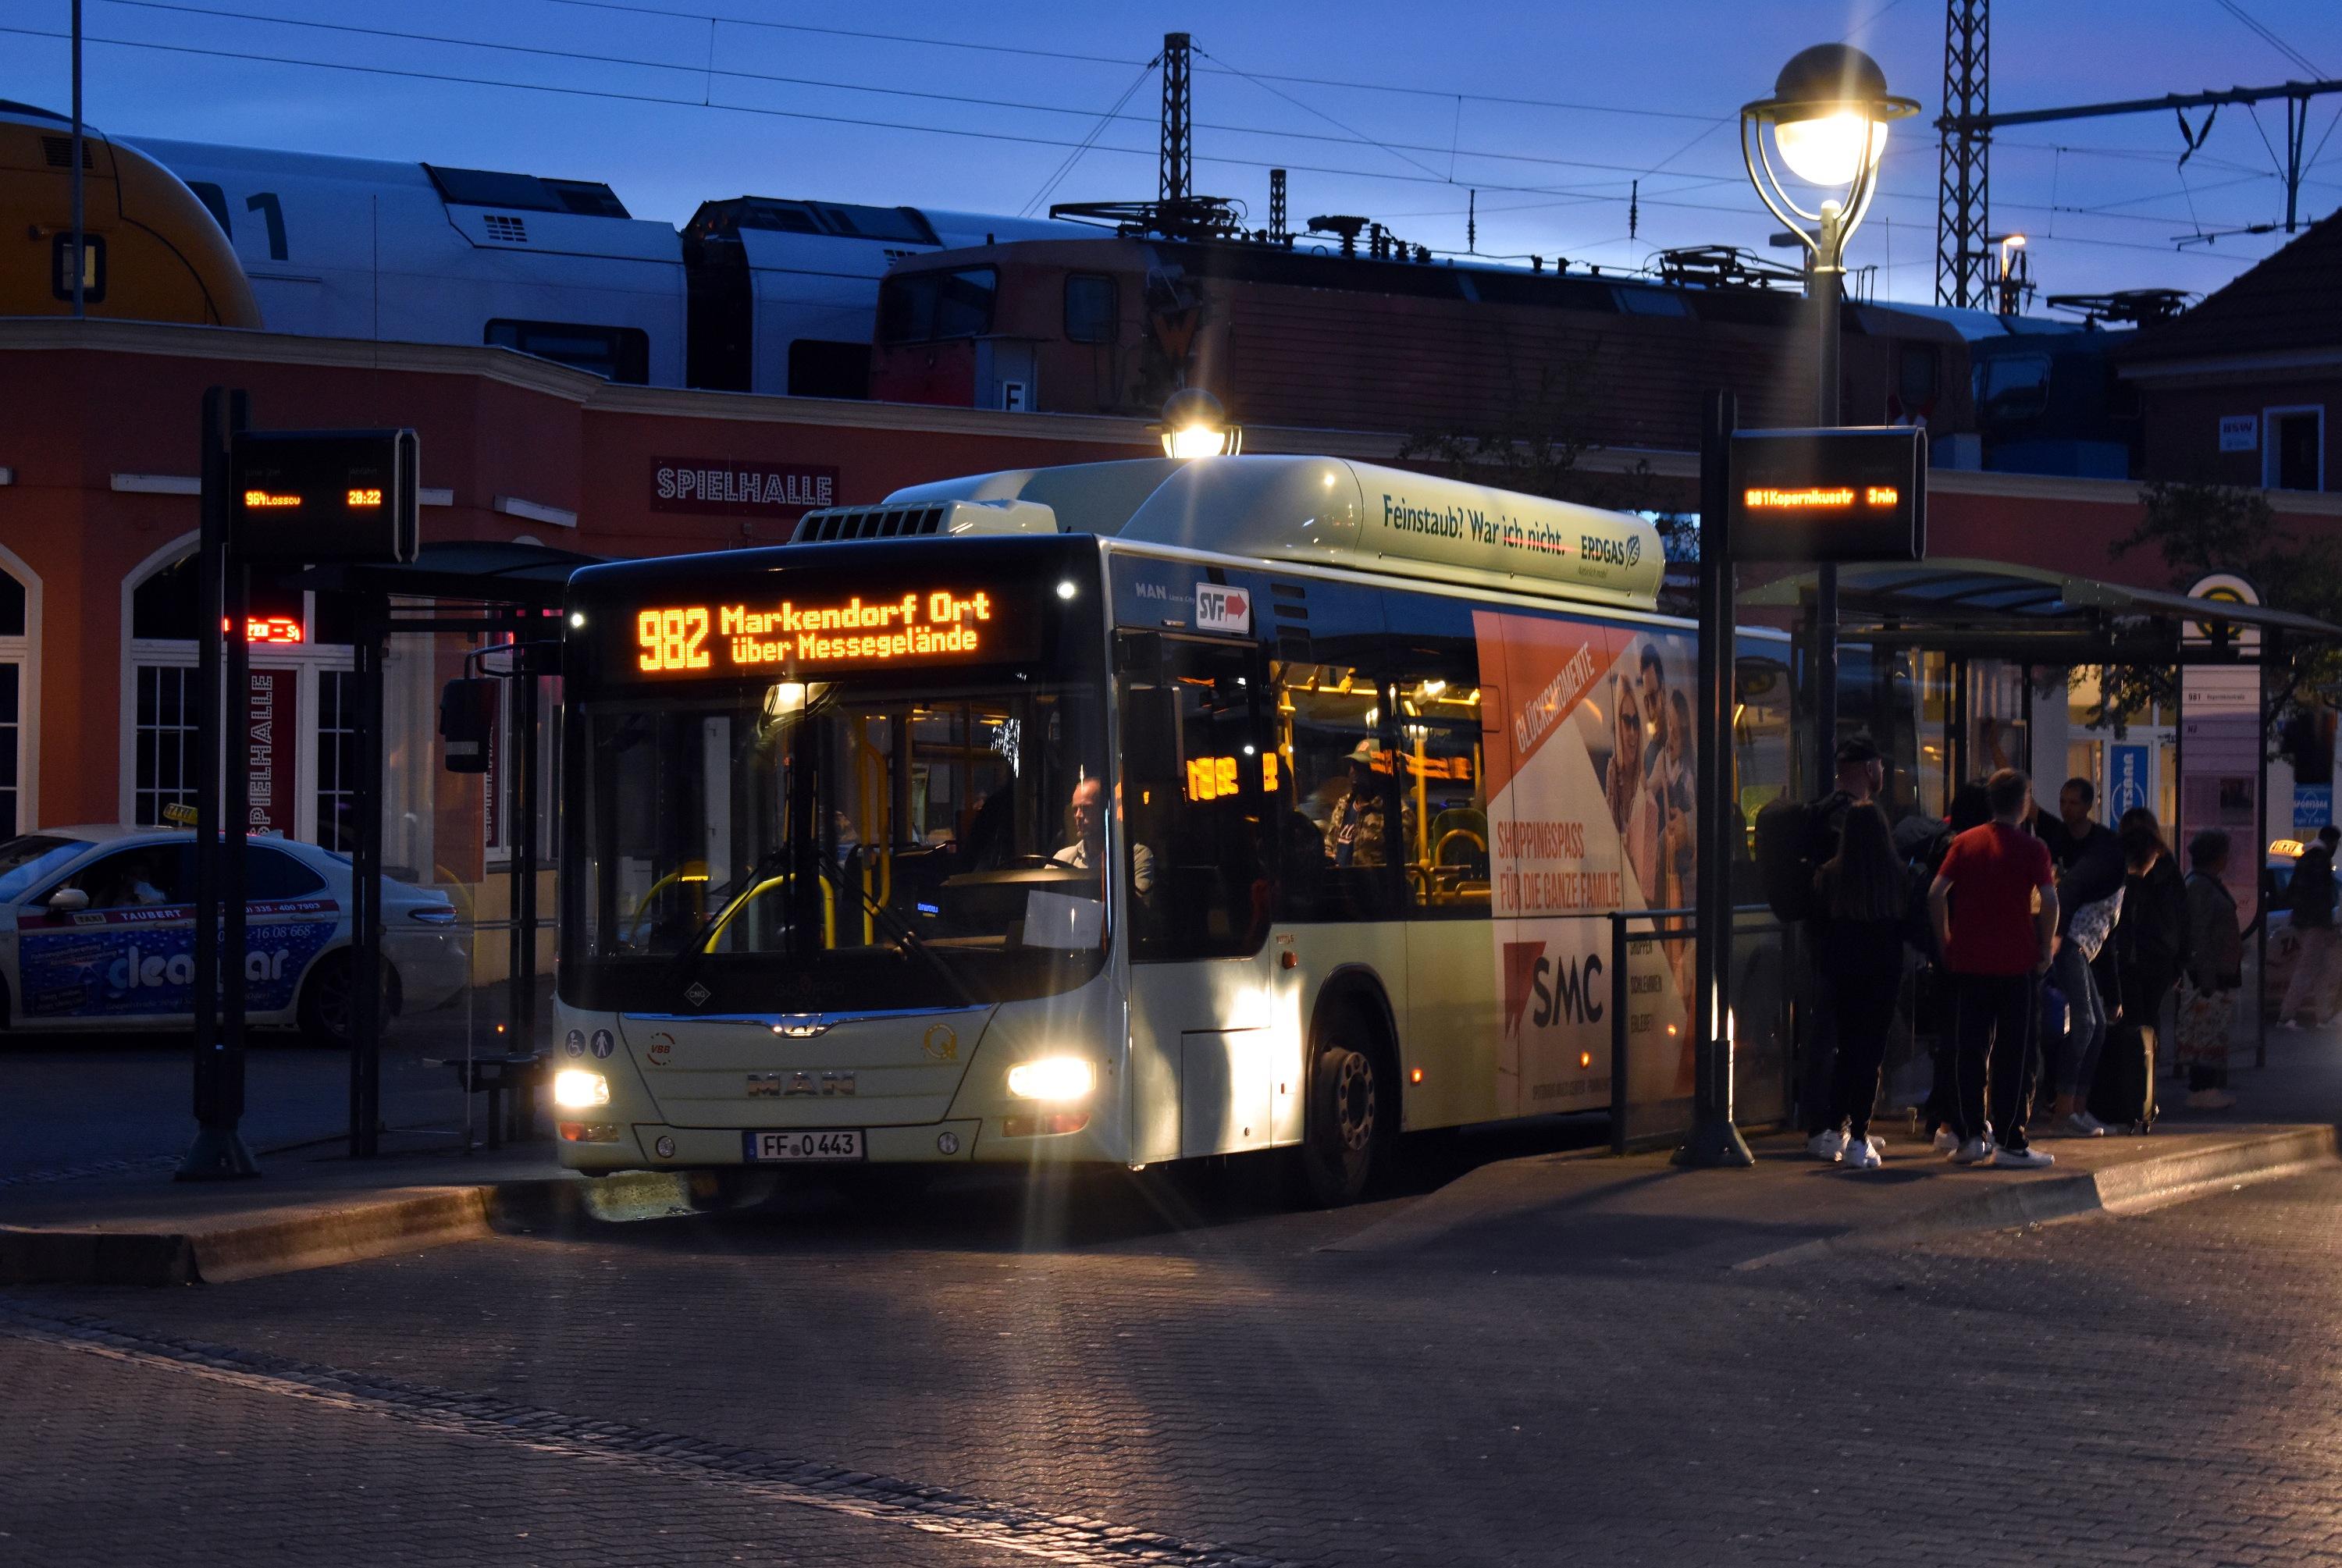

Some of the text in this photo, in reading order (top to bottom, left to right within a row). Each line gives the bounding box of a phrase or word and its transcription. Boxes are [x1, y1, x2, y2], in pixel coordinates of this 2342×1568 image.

[266, 494, 301, 506] Lossow
[348, 490, 382, 505] 20:22
[657, 468, 832, 507] SPIELHALLE
[1747, 491, 1769, 506] 981
[1383, 494, 1565, 556] Feinstaub? War ich nicht.
[1581, 535, 1625, 565] ERDGAS
[1135, 581, 1167, 600] MAN
[1200, 592, 1225, 621] SVF
[248, 624, 269, 636] PEN
[639, 592, 990, 670] 982 Markendorf Ort
[732, 624, 977, 663] über Messegelände
[1515, 641, 1596, 754] GLÜCKSMOMENTE
[1497, 820, 1585, 859] SHOPPINGSPASS
[1500, 865, 1621, 911] FÜR DIE GANZE FAMILIE
[121, 909, 181, 921] TAUBERT
[299, 902, 320, 911] 7903
[256, 928, 269, 939] 16
[290, 925, 311, 937] 668
[109, 944, 289, 989] cleaar
[689, 990, 706, 999] CNG
[1533, 954, 1603, 1028] SMC
[1630, 1014, 1652, 1033] ERLEBE
[651, 1045, 671, 1054] VBB
[748, 1071, 856, 1097] MAN
[763, 1135, 789, 1156] FF
[818, 1134, 854, 1155] 443
